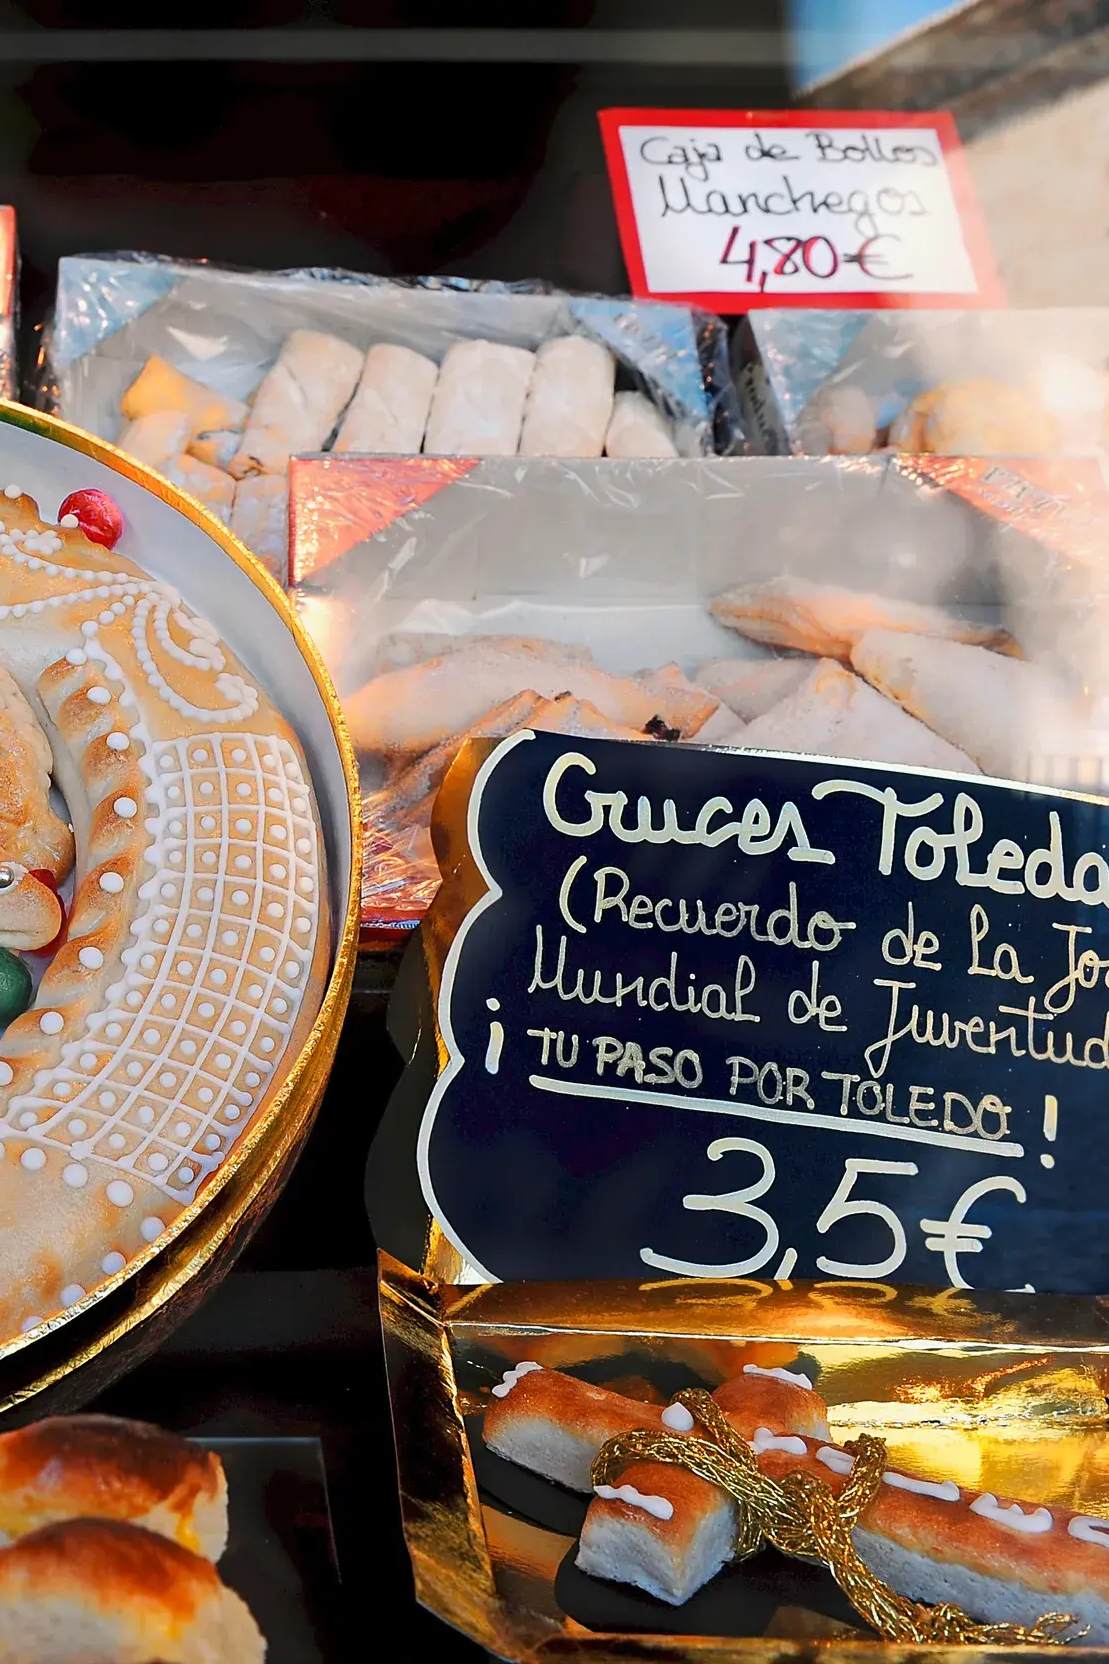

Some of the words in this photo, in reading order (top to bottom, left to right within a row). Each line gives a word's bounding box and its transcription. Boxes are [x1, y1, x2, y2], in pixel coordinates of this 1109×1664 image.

[640, 136, 723, 181] Caja
[745, 131, 800, 162] de
[805, 132, 941, 166] Bollos
[660, 175, 932, 238] Manchegos
[542, 751, 836, 864] Cruces
[559, 855, 856, 951] (Recuerdo
[882, 901, 942, 972] de
[1043, 922, 1109, 1014] Jo
[527, 924, 761, 1023] Mundial
[788, 960, 848, 1032] de
[865, 979, 1109, 1078] Juventud
[527, 1027, 580, 1069] TU
[593, 1037, 704, 1088] PASO
[727, 1056, 816, 1110] POR
[822, 1071, 1013, 1141] TOLEDO
